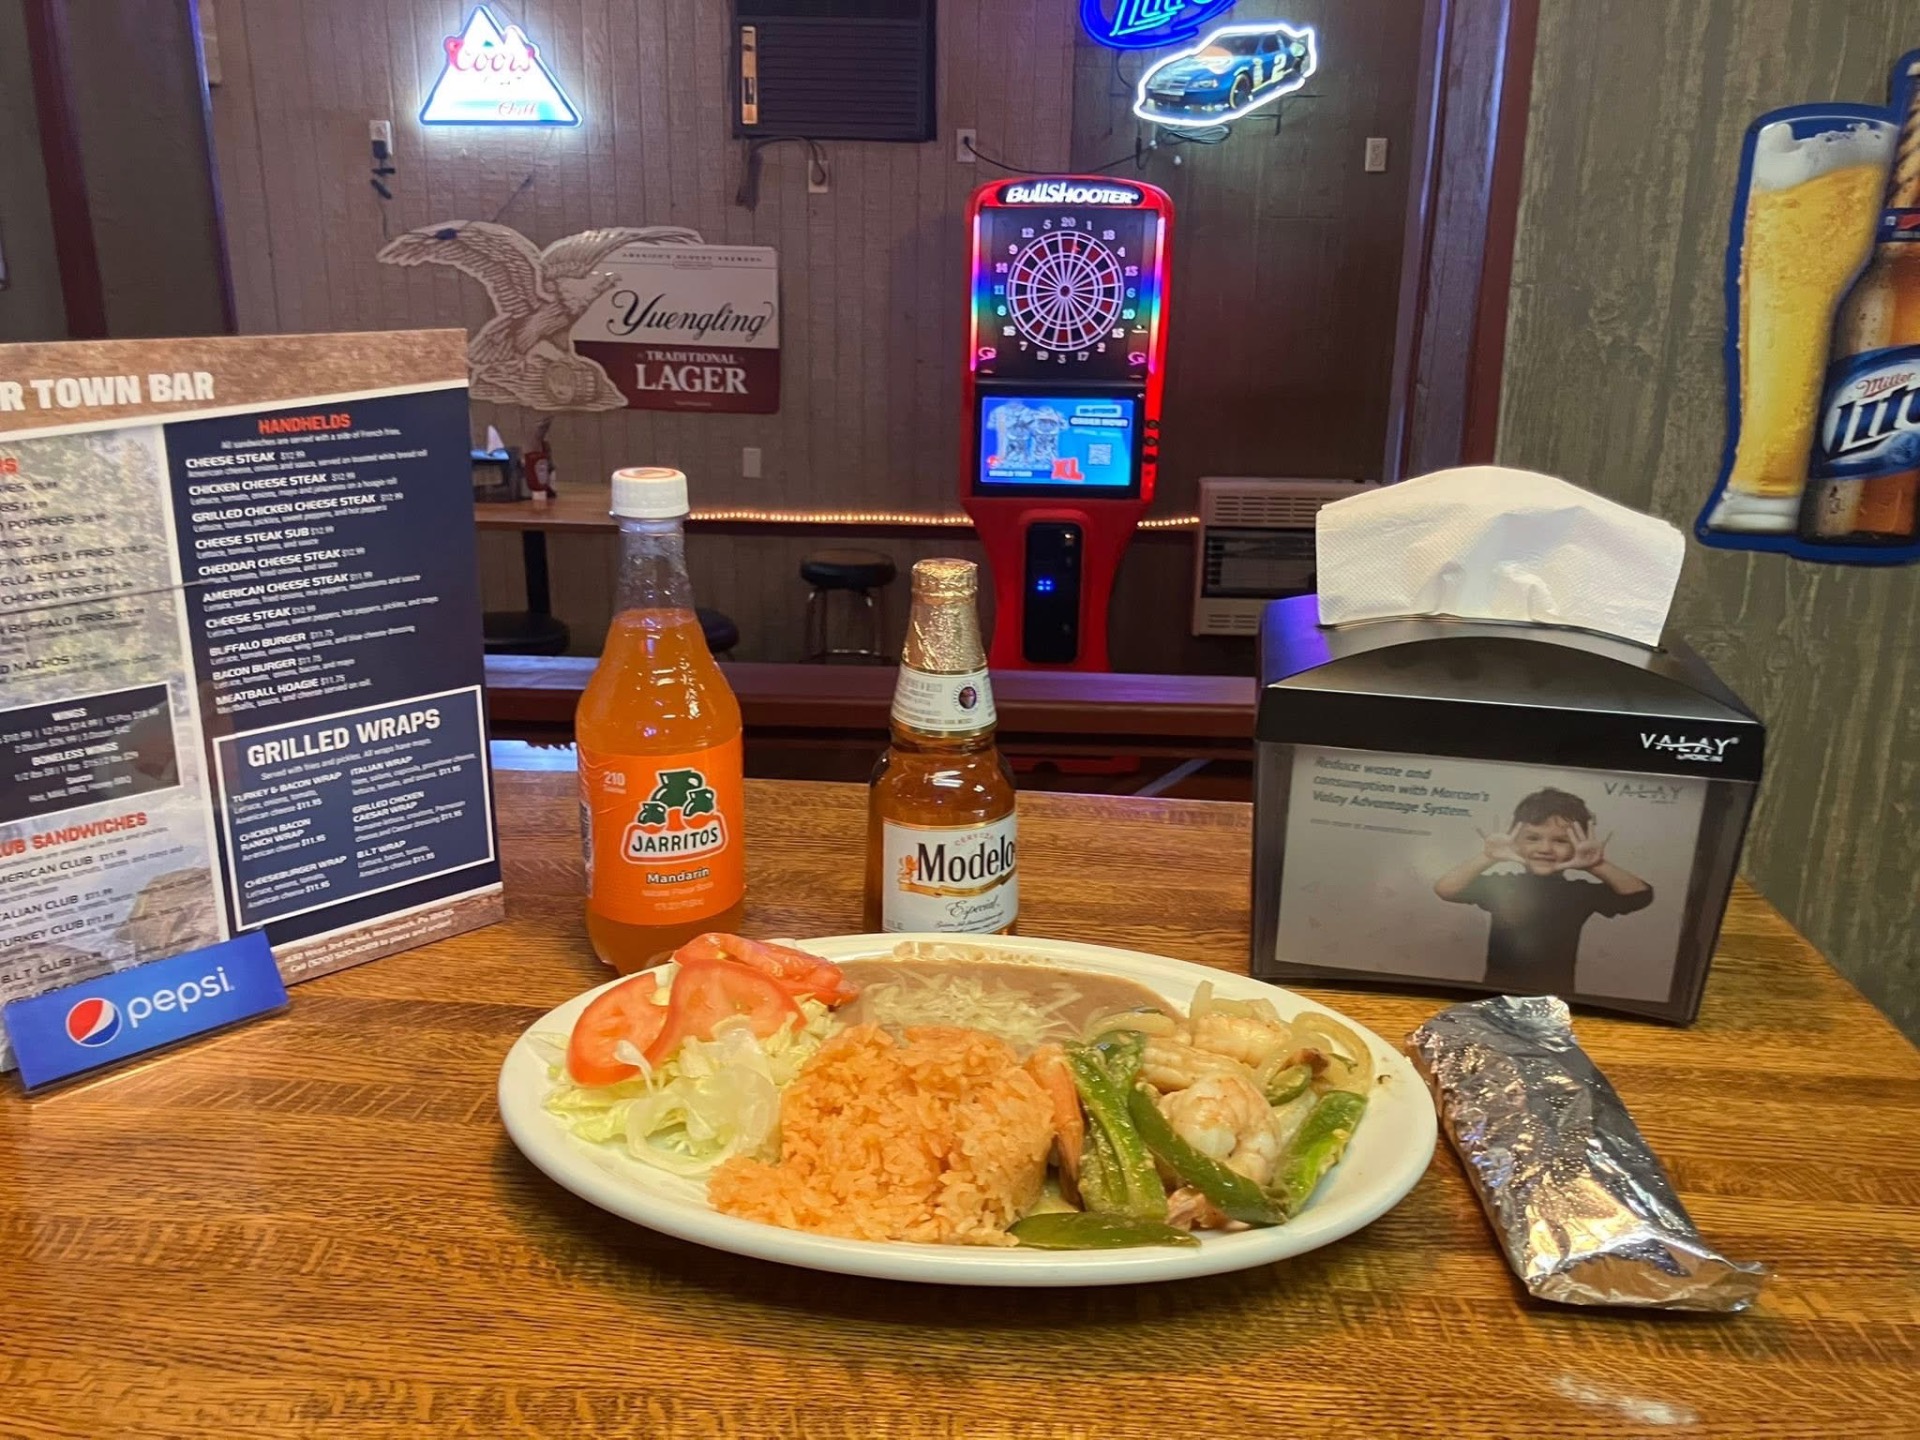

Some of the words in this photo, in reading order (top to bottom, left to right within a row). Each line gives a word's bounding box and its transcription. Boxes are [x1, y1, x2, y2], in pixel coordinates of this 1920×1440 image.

[1043, 220, 1051, 229] 5
[1061, 217, 1076, 227] 20
[1086, 221, 1092, 230] 1
[1117, 247, 1126, 257] 4
[993, 285, 1004, 295] 11
[1126, 288, 1136, 298] 6
[606, 289, 774, 342] Yuengling
[1122, 309, 1135, 320] 10
[645, 350, 735, 364] TRADITIONAL
[1019, 342, 1028, 351] 7
[635, 363, 748, 394] LAGER
[1855, 372, 1916, 398] Miller
[30, 375, 142, 409] TOWN
[148, 371, 216, 402] BAR
[257, 414, 351, 435] HANDHELDS
[186, 454, 236, 469] CHEESE
[236, 452, 275, 465] STEAK
[188, 482, 240, 496] CHICKEN
[242, 478, 288, 490] CHEESE
[289, 474, 327, 486] STEAK
[192, 508, 243, 522] GRILLED
[244, 504, 293, 517] CHICKEN
[294, 499, 338, 512] CHEESE
[340, 494, 376, 507] STEAK
[195, 535, 243, 549] CHEESE
[244, 531, 283, 544] STEAK
[284, 527, 310, 539] SUB
[198, 560, 256, 576] CHEDDAR
[258, 554, 303, 568] CHEESE
[304, 549, 341, 562] STEAK
[203, 584, 265, 602] AMERICAN
[266, 578, 311, 593] CHEESE
[312, 573, 348, 587] STEAK
[205, 613, 252, 629] CHEESE
[253, 607, 292, 621] STEAK
[209, 639, 260, 657] BUFFALO
[261, 632, 306, 648] BURGER
[212, 666, 250, 681] BACON
[252, 658, 297, 674] BURGER
[215, 685, 276, 706] MEATBALL
[276, 678, 319, 693] HOAGIE
[247, 727, 350, 768] GRILLED
[355, 708, 441, 745] WRAPS
[1640, 732, 1732, 756] VALAY
[349, 762, 384, 776] ITALIAN
[385, 756, 414, 769] WRAP
[1315, 756, 1362, 773] Reduce
[1364, 765, 1402, 778] waste
[1404, 768, 1432, 780] and
[231, 788, 269, 803] TURKEY
[281, 778, 312, 792] BACON
[313, 772, 343, 786] WRAP
[1313, 775, 1395, 794] consumption
[1398, 784, 1428, 797] with
[1603, 781, 1683, 800] VALAY
[351, 798, 387, 814] GRILLED
[388, 791, 425, 805] CHICKEN
[352, 809, 385, 823] CAESAR
[387, 802, 417, 815] WRAP
[1312, 790, 1348, 806] Valay
[1350, 795, 1419, 814] Advantage
[31, 812, 148, 850] SANDWICHES
[239, 827, 278, 842] CHICKEN
[280, 818, 312, 833] BACON
[240, 836, 274, 851] RANCH
[275, 829, 304, 843] WRAP
[632, 826, 718, 852] JARRITOS
[378, 840, 406, 853] WRAP
[59, 856, 93, 870] CLUB
[916, 834, 1016, 882] Modelo
[244, 863, 318, 888] CHEESEBURGER
[318, 855, 347, 870] WRAP
[646, 867, 710, 885] Mandarin
[45, 895, 79, 911] CLUB
[50, 920, 84, 935] CLUB
[40, 957, 72, 974] CLUB
[127, 966, 230, 1029] pepsi
